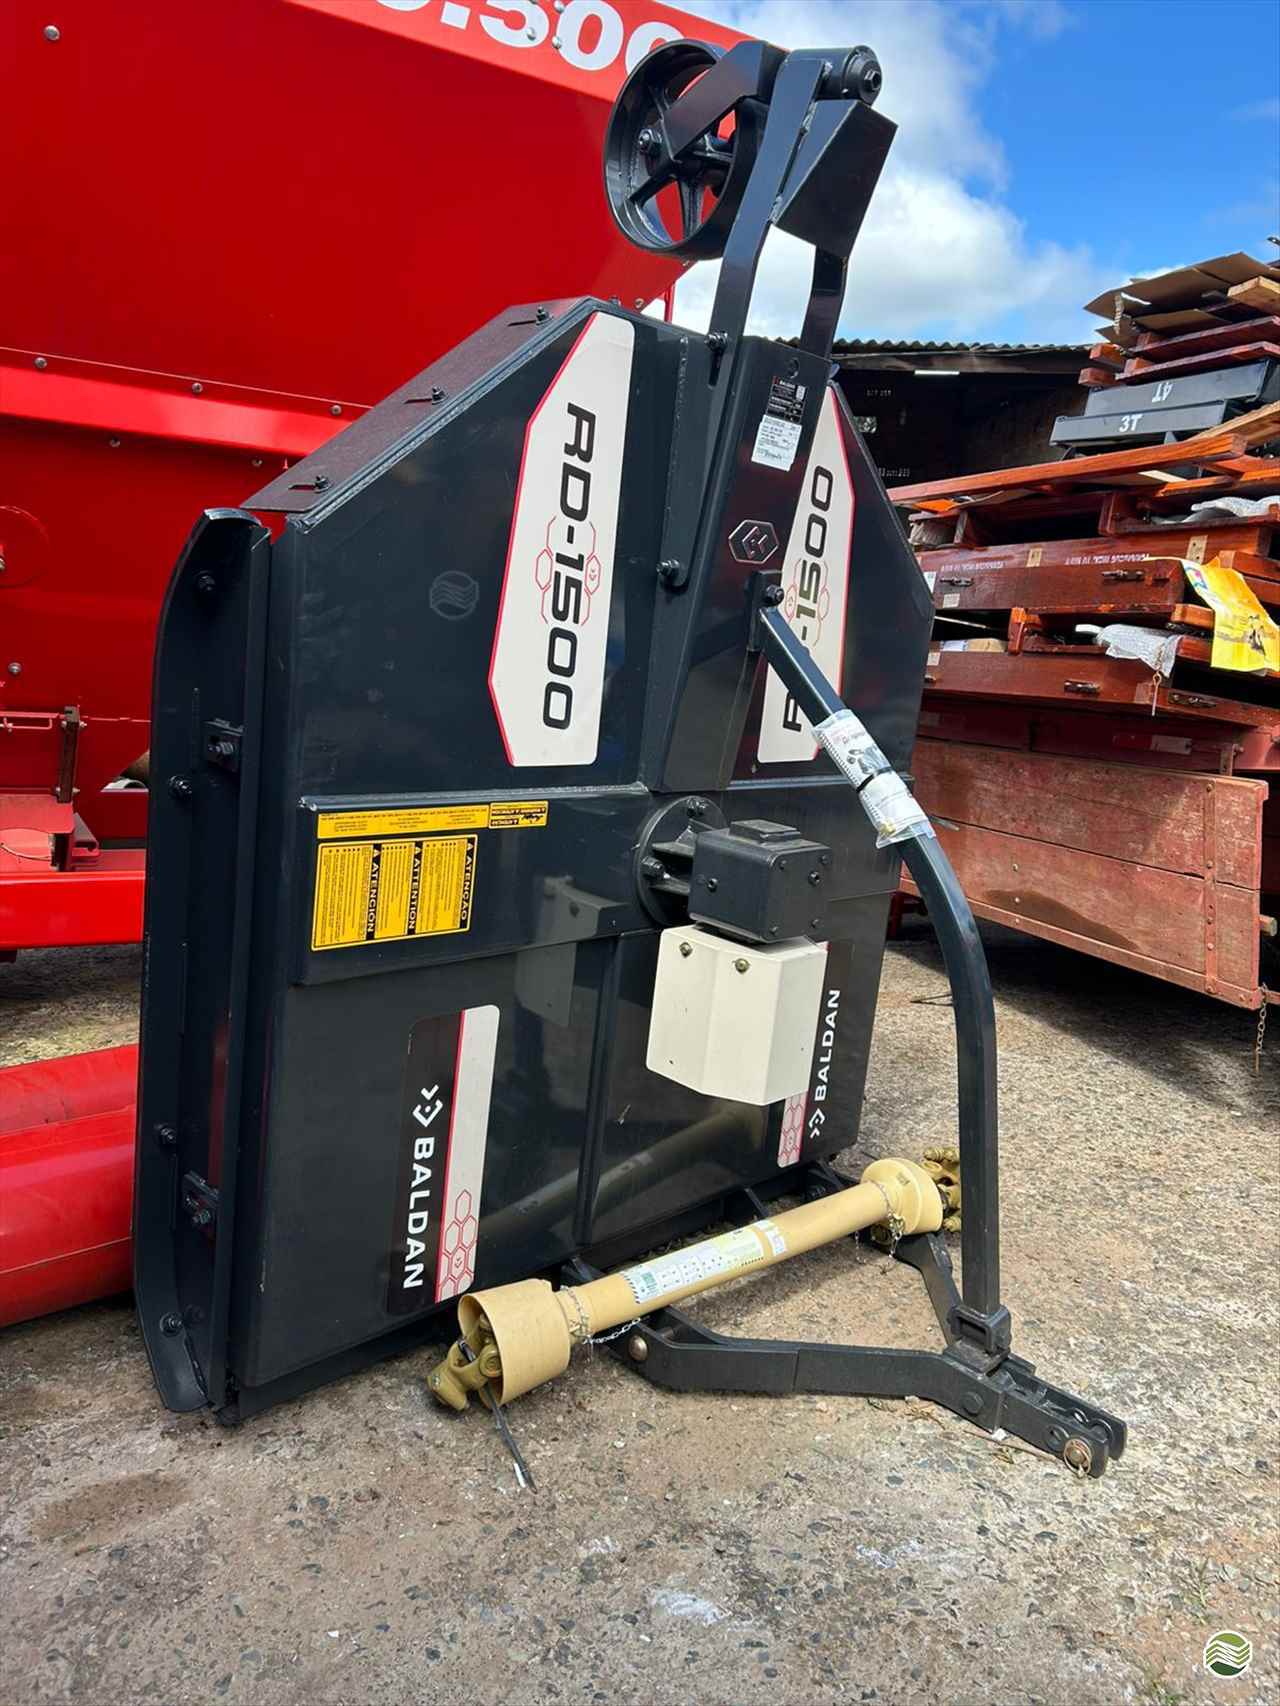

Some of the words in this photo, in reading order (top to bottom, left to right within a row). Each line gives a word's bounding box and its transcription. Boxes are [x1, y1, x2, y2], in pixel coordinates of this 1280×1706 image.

[1119, 413, 1142, 432] 3T
[543, 402, 596, 730] RD-1500
[783, 465, 833, 732] R-1500
[409, 857, 421, 930] ATTENTION
[813, 989, 841, 1102] BALDAN
[403, 1136, 436, 1290] BALDAN
